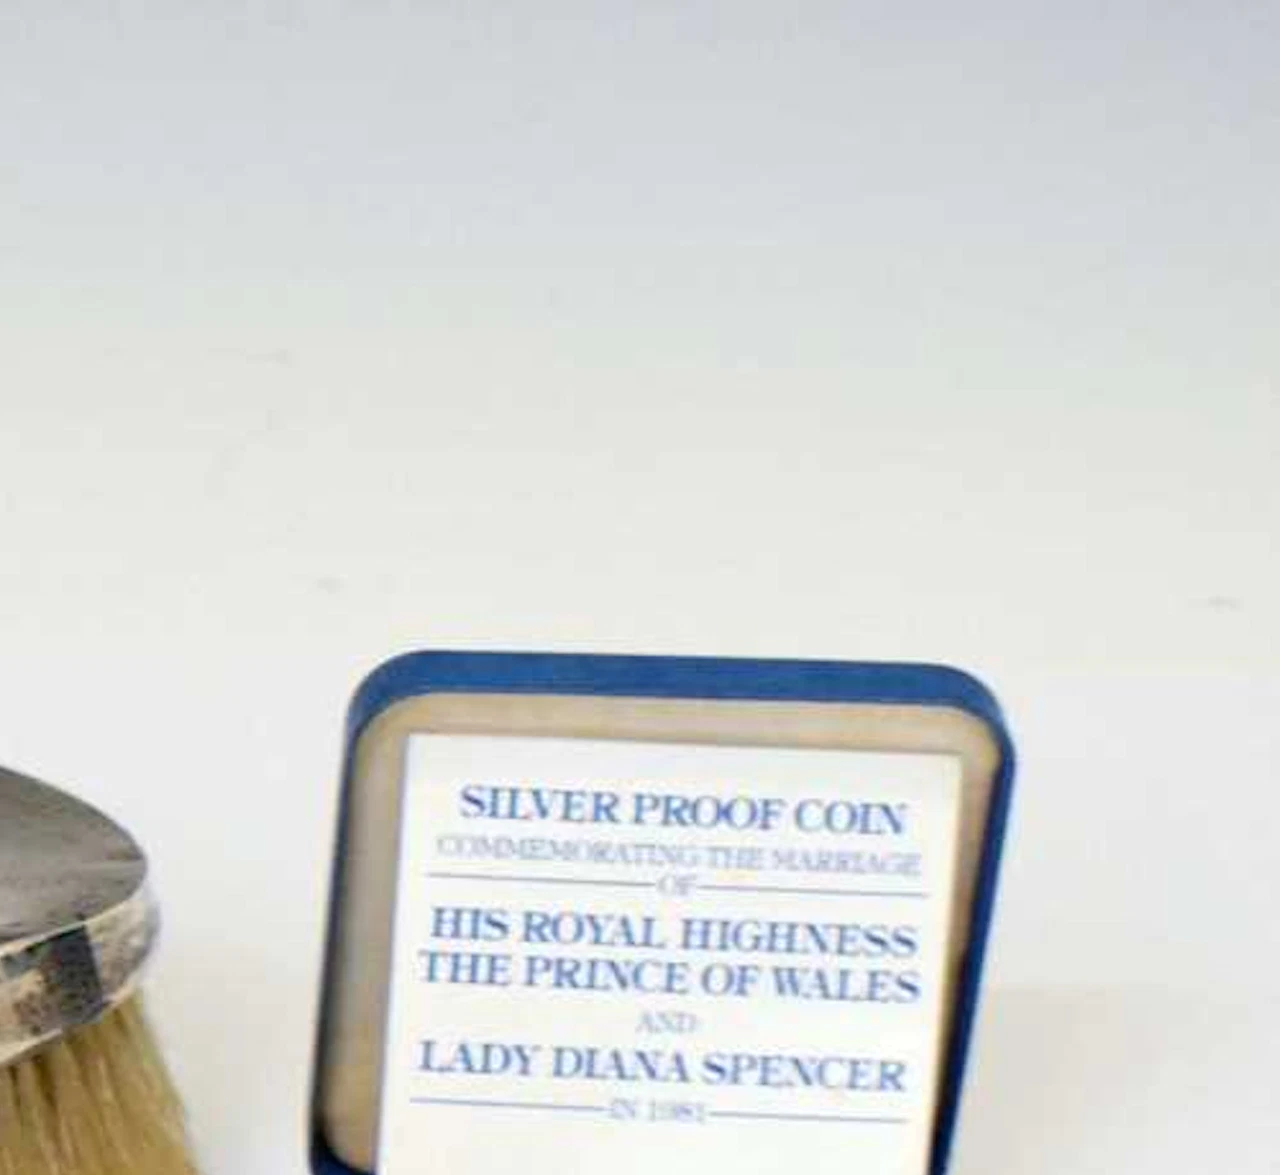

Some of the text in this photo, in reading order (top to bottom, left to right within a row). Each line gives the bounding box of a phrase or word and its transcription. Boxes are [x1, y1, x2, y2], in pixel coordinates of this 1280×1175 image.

[460, 784, 909, 835] SILVER PROOF COIN
[437, 836, 921, 876] COMMEMORATING THE MARRIAGE
[657, 874, 698, 896] OF
[430, 905, 918, 957] HIS ROYAL HIGHNESS
[419, 951, 921, 1003] THE PRINCE OF WALES
[636, 1012, 700, 1033] AND
[419, 1040, 907, 1092] LADY DIANA SPENCER
[610, 1098, 639, 1121] IN
